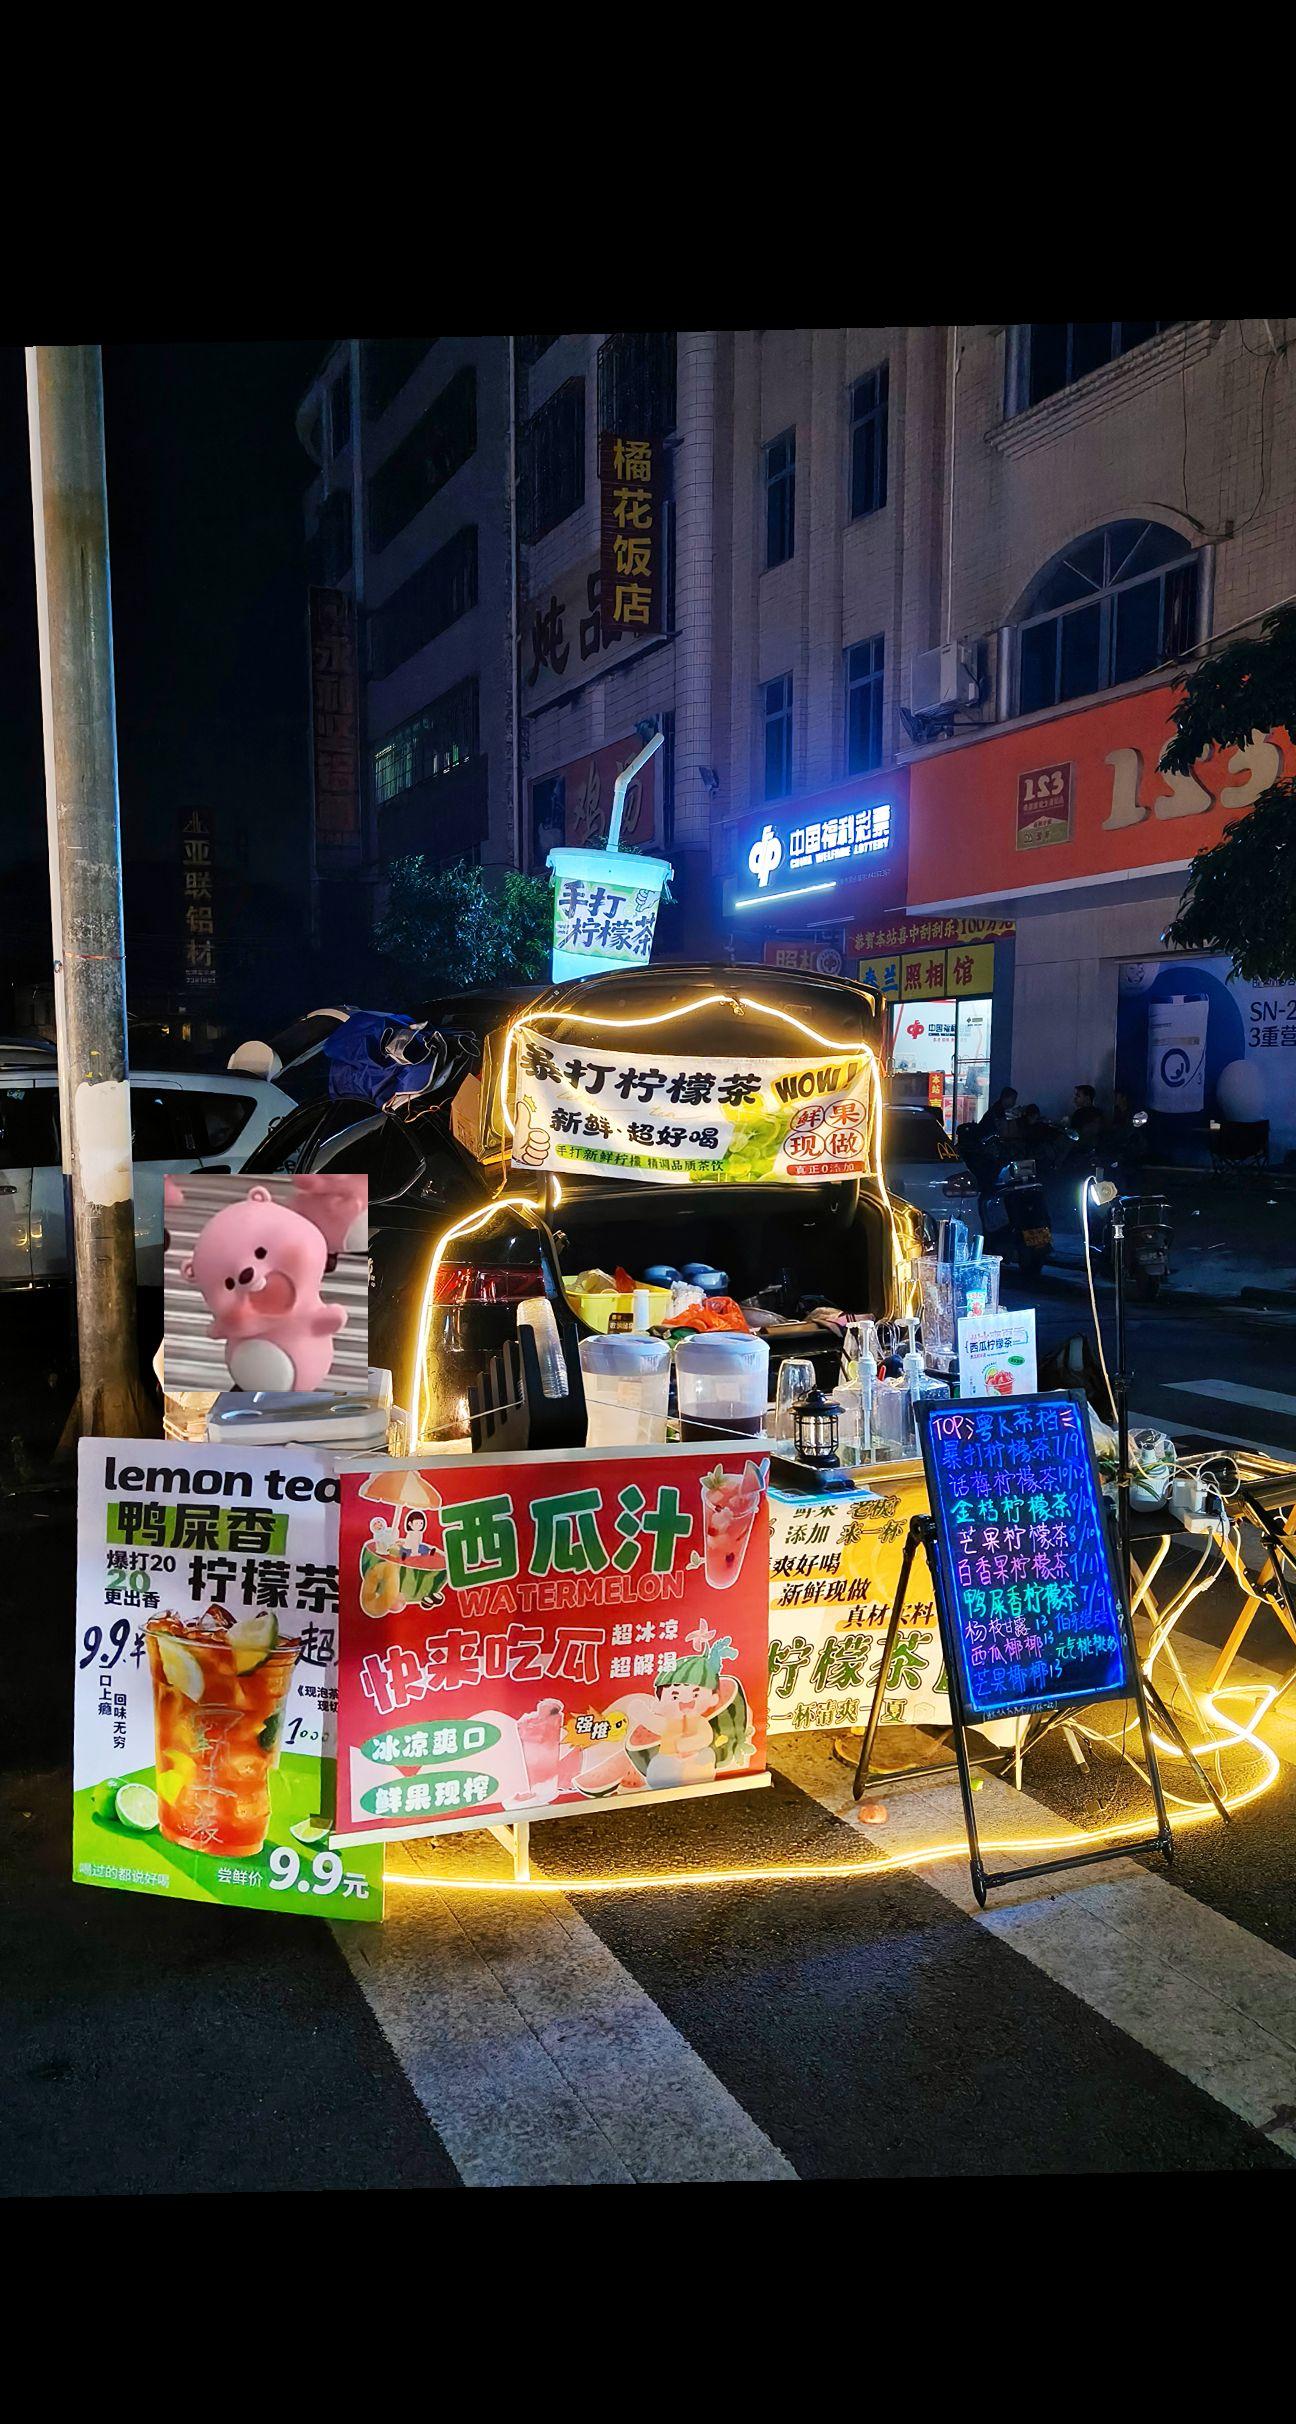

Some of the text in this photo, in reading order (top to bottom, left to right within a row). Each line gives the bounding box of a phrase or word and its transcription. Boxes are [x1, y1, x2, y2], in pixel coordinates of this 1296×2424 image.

[612, 437, 653, 626] 橘花饭店
[527, 569, 640, 687] 炖品
[1024, 771, 1064, 801] 123
[789, 805, 891, 857] 中国福利彩票
[789, 837, 890, 869] CHINA WELFARE LOTTERY
[183, 840, 214, 967] 亚联铝材
[559, 880, 626, 918] 手打
[558, 913, 656, 956] 柠檬茶
[519, 1041, 762, 1107] 暴打柠檬茶
[795, 1099, 860, 1127] 鲜果
[556, 1144, 724, 1173] 手打新鲜柠檬 精调品质茶饮
[790, 1129, 859, 1159] 现做
[796, 1163, 855, 1175] 真正0添加
[942, 1435, 1052, 1470] 暴打柠檬茶
[104, 1456, 341, 1504] lemon tea
[950, 1493, 1072, 1524] 金桔柠檬茶
[116, 1501, 277, 1555] 鸭屎香
[439, 1484, 694, 1589] 西瓜汁
[784, 1522, 831, 1545] 添加
[836, 1518, 908, 1545] 来一杯
[959, 1521, 1070, 1554] 芒果柠檬茶
[106, 1550, 177, 1573] 爆打20
[768, 1552, 842, 1579] 爽好喝
[958, 1550, 1070, 1587] 百香果柠檬茶
[104, 1587, 161, 1609] 更出香
[106, 1570, 152, 1593] 20
[188, 1556, 339, 1616] 柠檬茶
[458, 1570, 685, 1619] WATERMELON
[777, 1578, 872, 1606] 新鲜现做
[295, 1621, 339, 1668] 超
[965, 1614, 1031, 1645] 杨枝甘露
[359, 1618, 680, 1716] 快来吃瓜 超冰凉
[609, 1650, 680, 1680] 超解渴
[767, 1630, 951, 1699] 柠檬茶
[971, 1634, 1044, 1667] 西瓜椰椰
[973, 1659, 1062, 1697] 芒果椰椰 13
[113, 1693, 127, 1749] 回味无穷
[575, 1714, 610, 1740] 强推
[766, 1699, 908, 1730] 一杯清爽一夏
[371, 1729, 487, 1763] 冰凉爽口
[374, 1779, 491, 1815] 鲜果现榨
[79, 1861, 170, 1889] 喝过的都说好喝
[217, 1846, 370, 1901] 尝鲜价 9.9元
